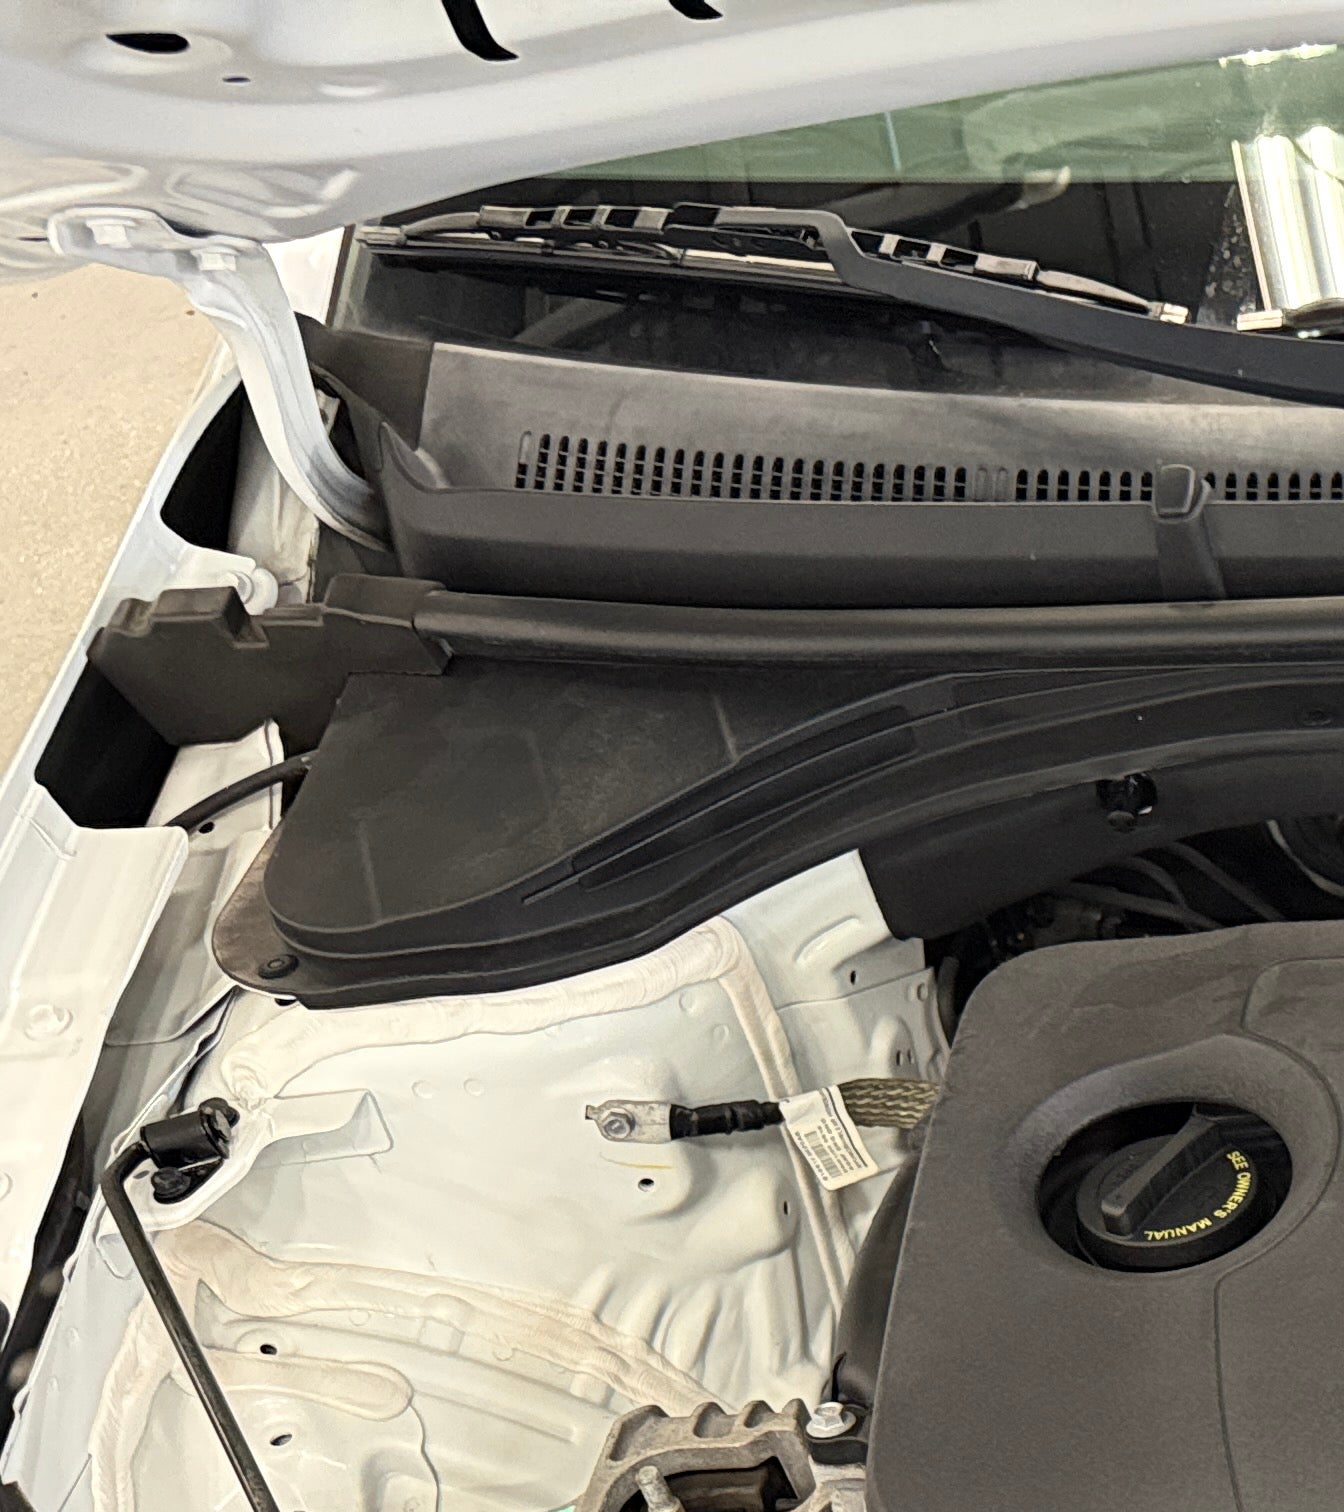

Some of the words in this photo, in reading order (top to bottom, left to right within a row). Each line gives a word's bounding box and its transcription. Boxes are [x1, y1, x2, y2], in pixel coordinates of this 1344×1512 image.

[1226, 1150, 1249, 1170] SEE
[1213, 1172, 1252, 1219] OWNER'S
[1144, 1217, 1213, 1241] MANUAL
